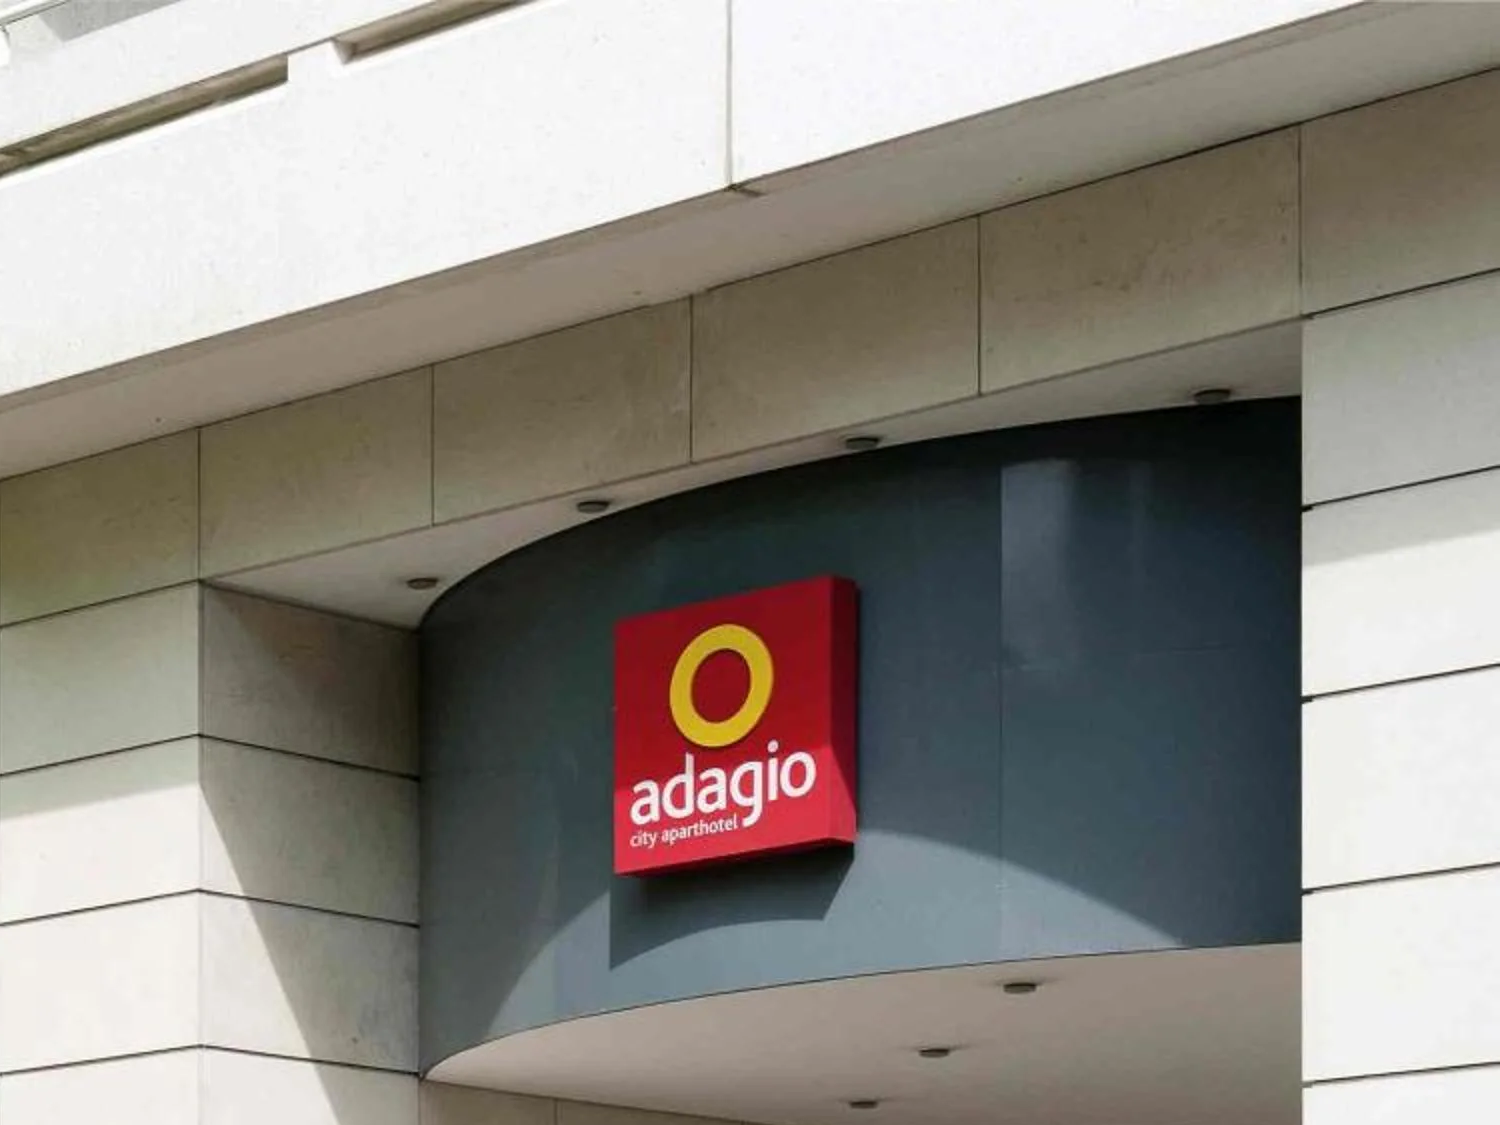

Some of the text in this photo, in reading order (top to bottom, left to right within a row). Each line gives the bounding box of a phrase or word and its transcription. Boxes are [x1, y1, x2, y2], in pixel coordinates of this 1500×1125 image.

[630, 739, 817, 827] adagio
[629, 814, 739, 849] city aparthotel
